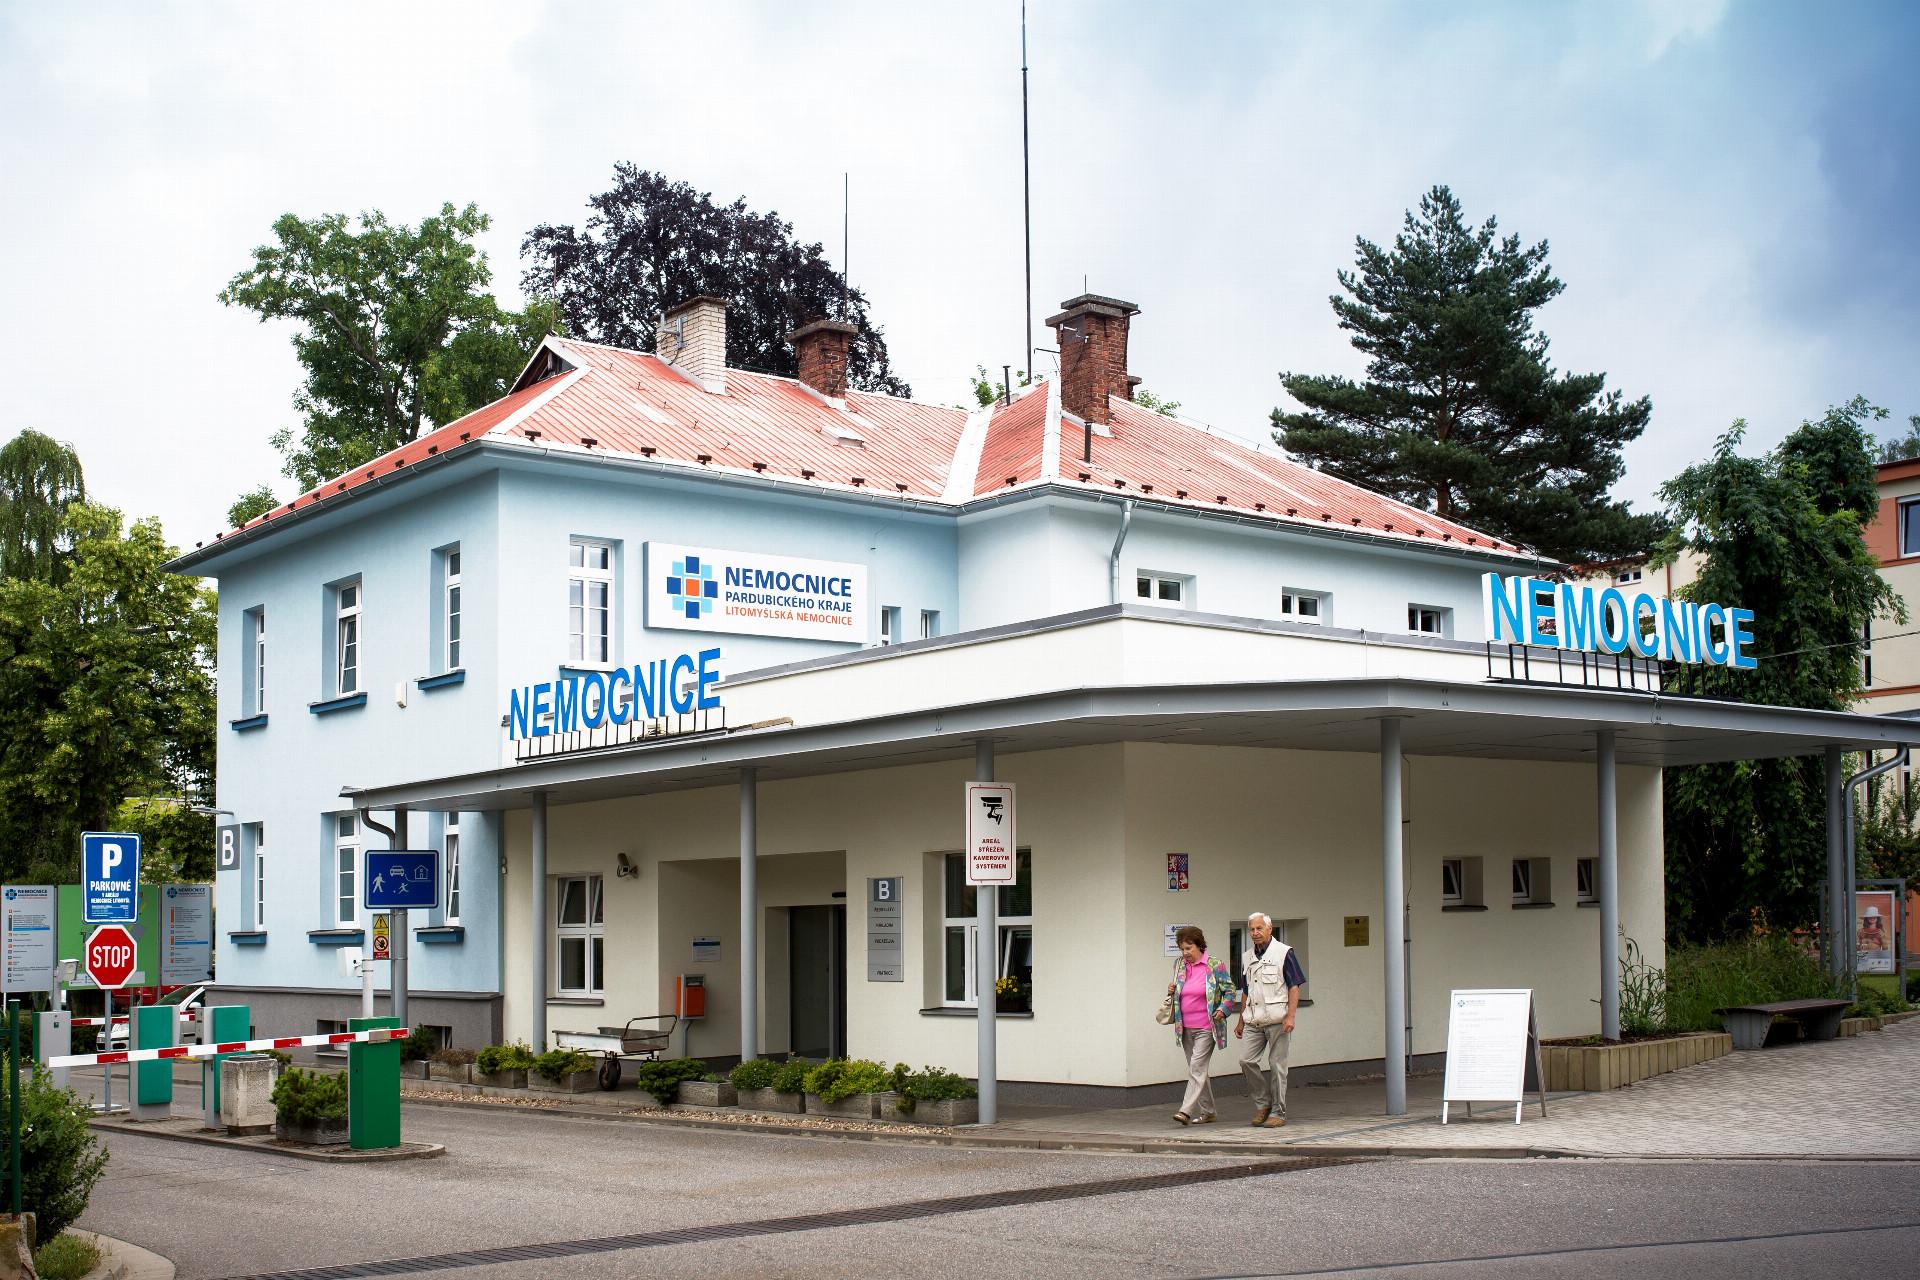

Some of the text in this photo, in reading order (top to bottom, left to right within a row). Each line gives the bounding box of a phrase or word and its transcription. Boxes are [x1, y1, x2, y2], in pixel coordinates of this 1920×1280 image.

[725, 566, 852, 597] NEMOCNICE
[725, 591, 852, 612] PARDUBICKÉHO KRAJE
[725, 606, 853, 625] LITOMYŠLSKÁ NEMOCNICE
[1481, 572, 1758, 669] NEMOCNICE
[509, 647, 721, 741] NEMOCNICE
[102, 843, 123, 879] P
[221, 829, 235, 866] B
[90, 879, 132, 892] PARKOVNÉ
[878, 880, 890, 900] B
[92, 945, 131, 969] STOP
